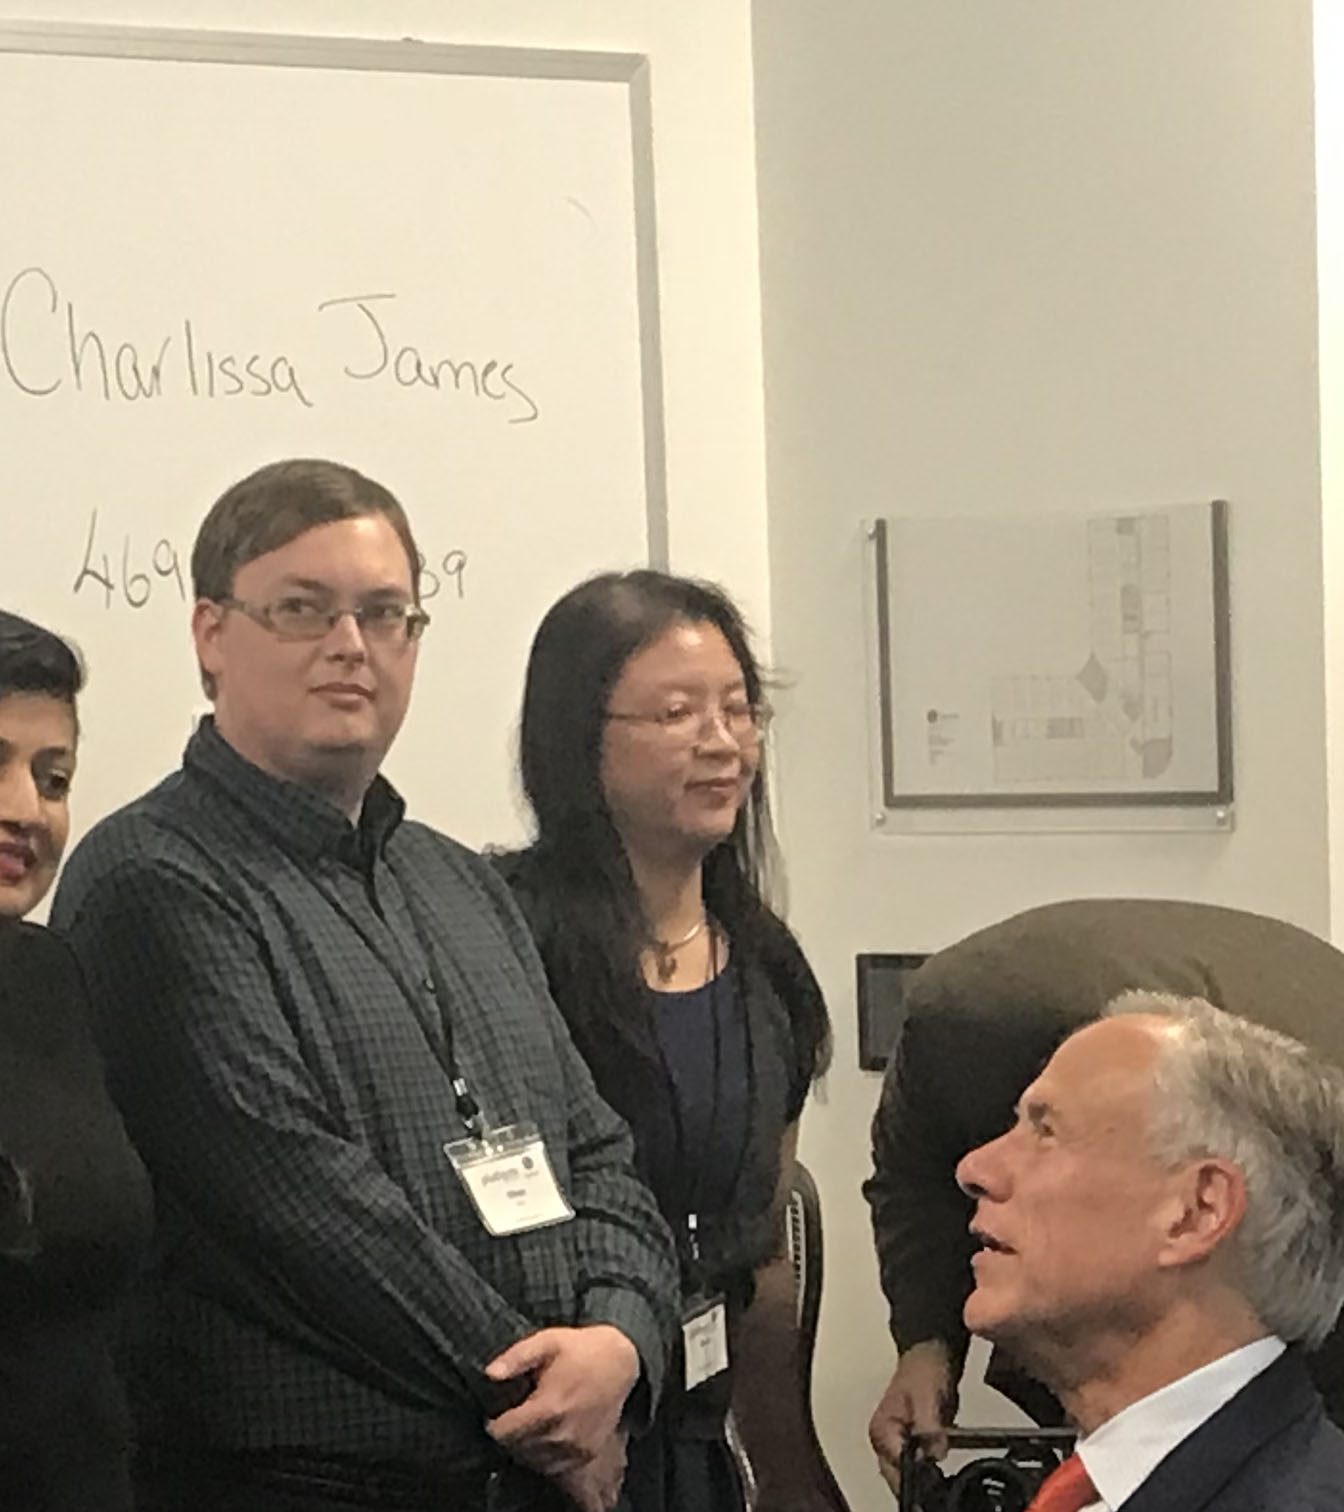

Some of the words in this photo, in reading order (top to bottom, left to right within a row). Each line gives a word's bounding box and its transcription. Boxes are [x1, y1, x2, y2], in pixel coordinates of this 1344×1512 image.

[1, 267, 314, 407] Charlissa
[319, 293, 538, 423] James
[73, 507, 186, 610] 469
